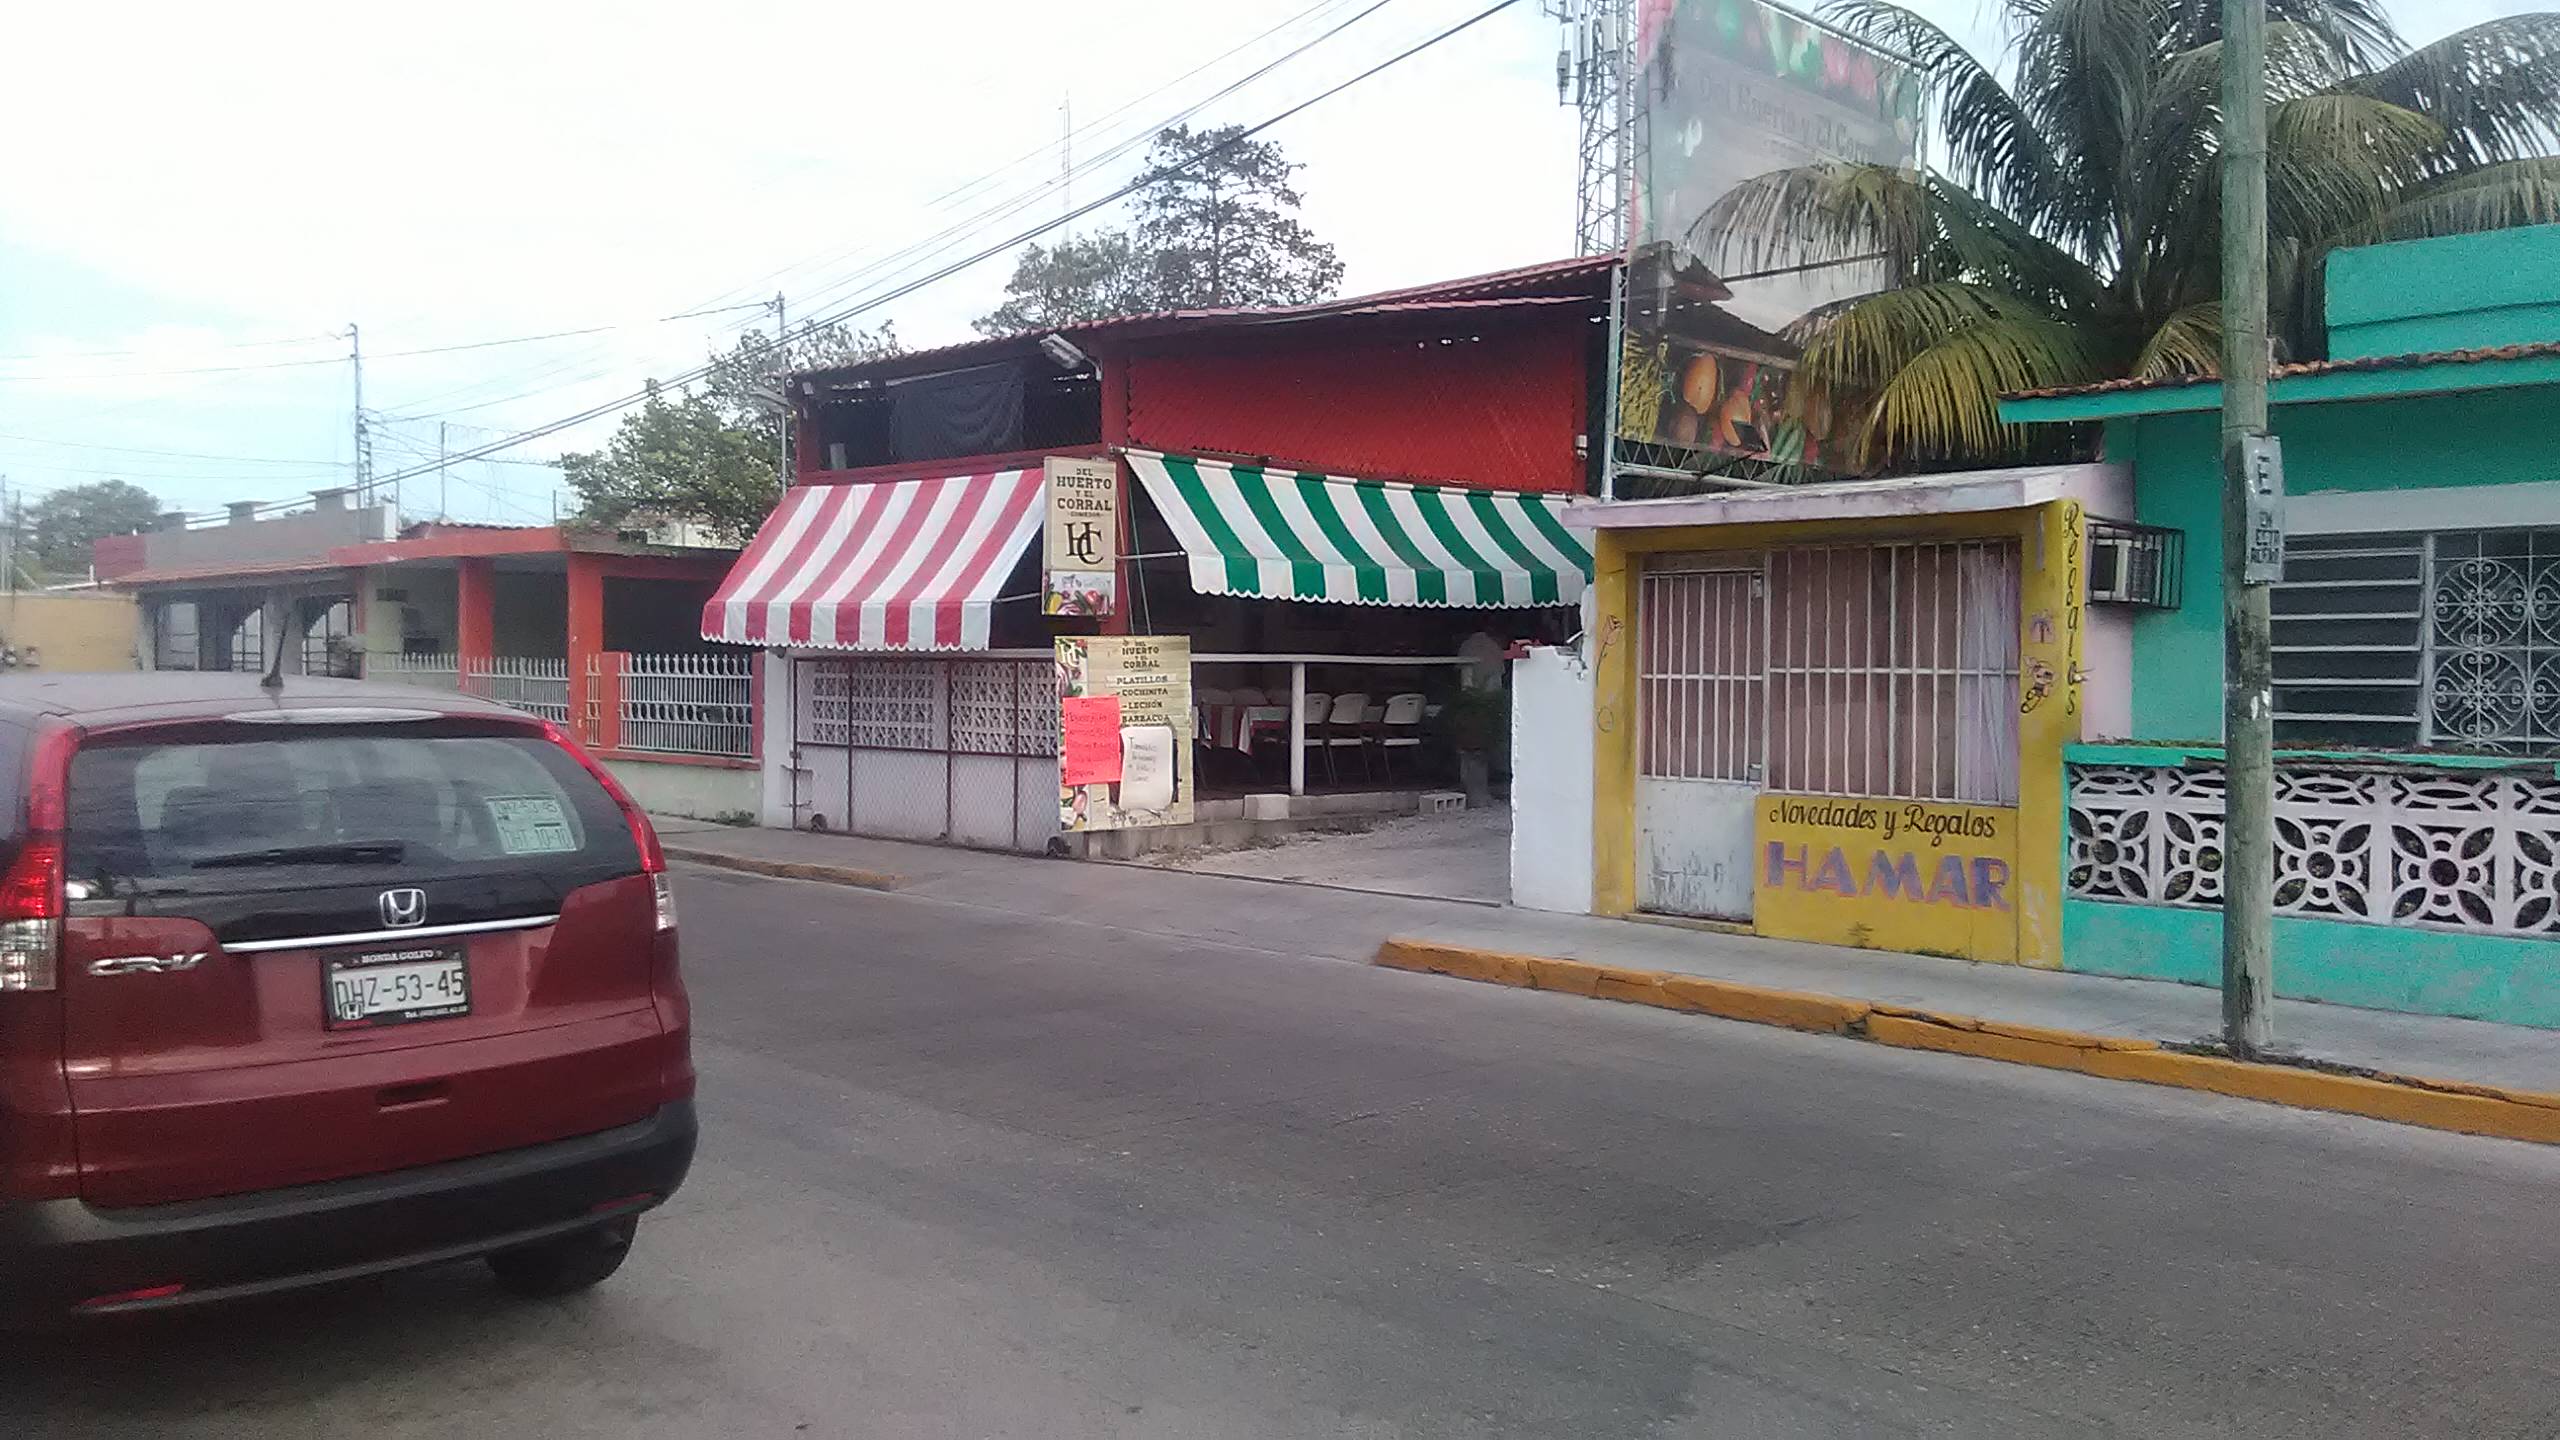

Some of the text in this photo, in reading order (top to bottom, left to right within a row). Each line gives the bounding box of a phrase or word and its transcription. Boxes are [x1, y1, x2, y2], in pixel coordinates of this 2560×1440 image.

[1076, 468, 1093, 477] DEL
[1056, 476, 1112, 490] HUERTO
[1075, 490, 1095, 498] Y EL
[1057, 498, 1112, 511] CORRAL
[1122, 646, 1160, 655] HUERTO
[1122, 660, 1160, 669] CORRAL
[1116, 675, 1168, 685] PLATILLOS
[1121, 688, 1169, 697] COCHINITA
[1128, 700, 1163, 710] LECHÓN
[1769, 799, 1996, 848] Novedades y Regalos
[1763, 840, 2012, 912] HAMAR
[88, 952, 208, 976] CR-V
[334, 968, 464, 1011] DHZ-53-45
